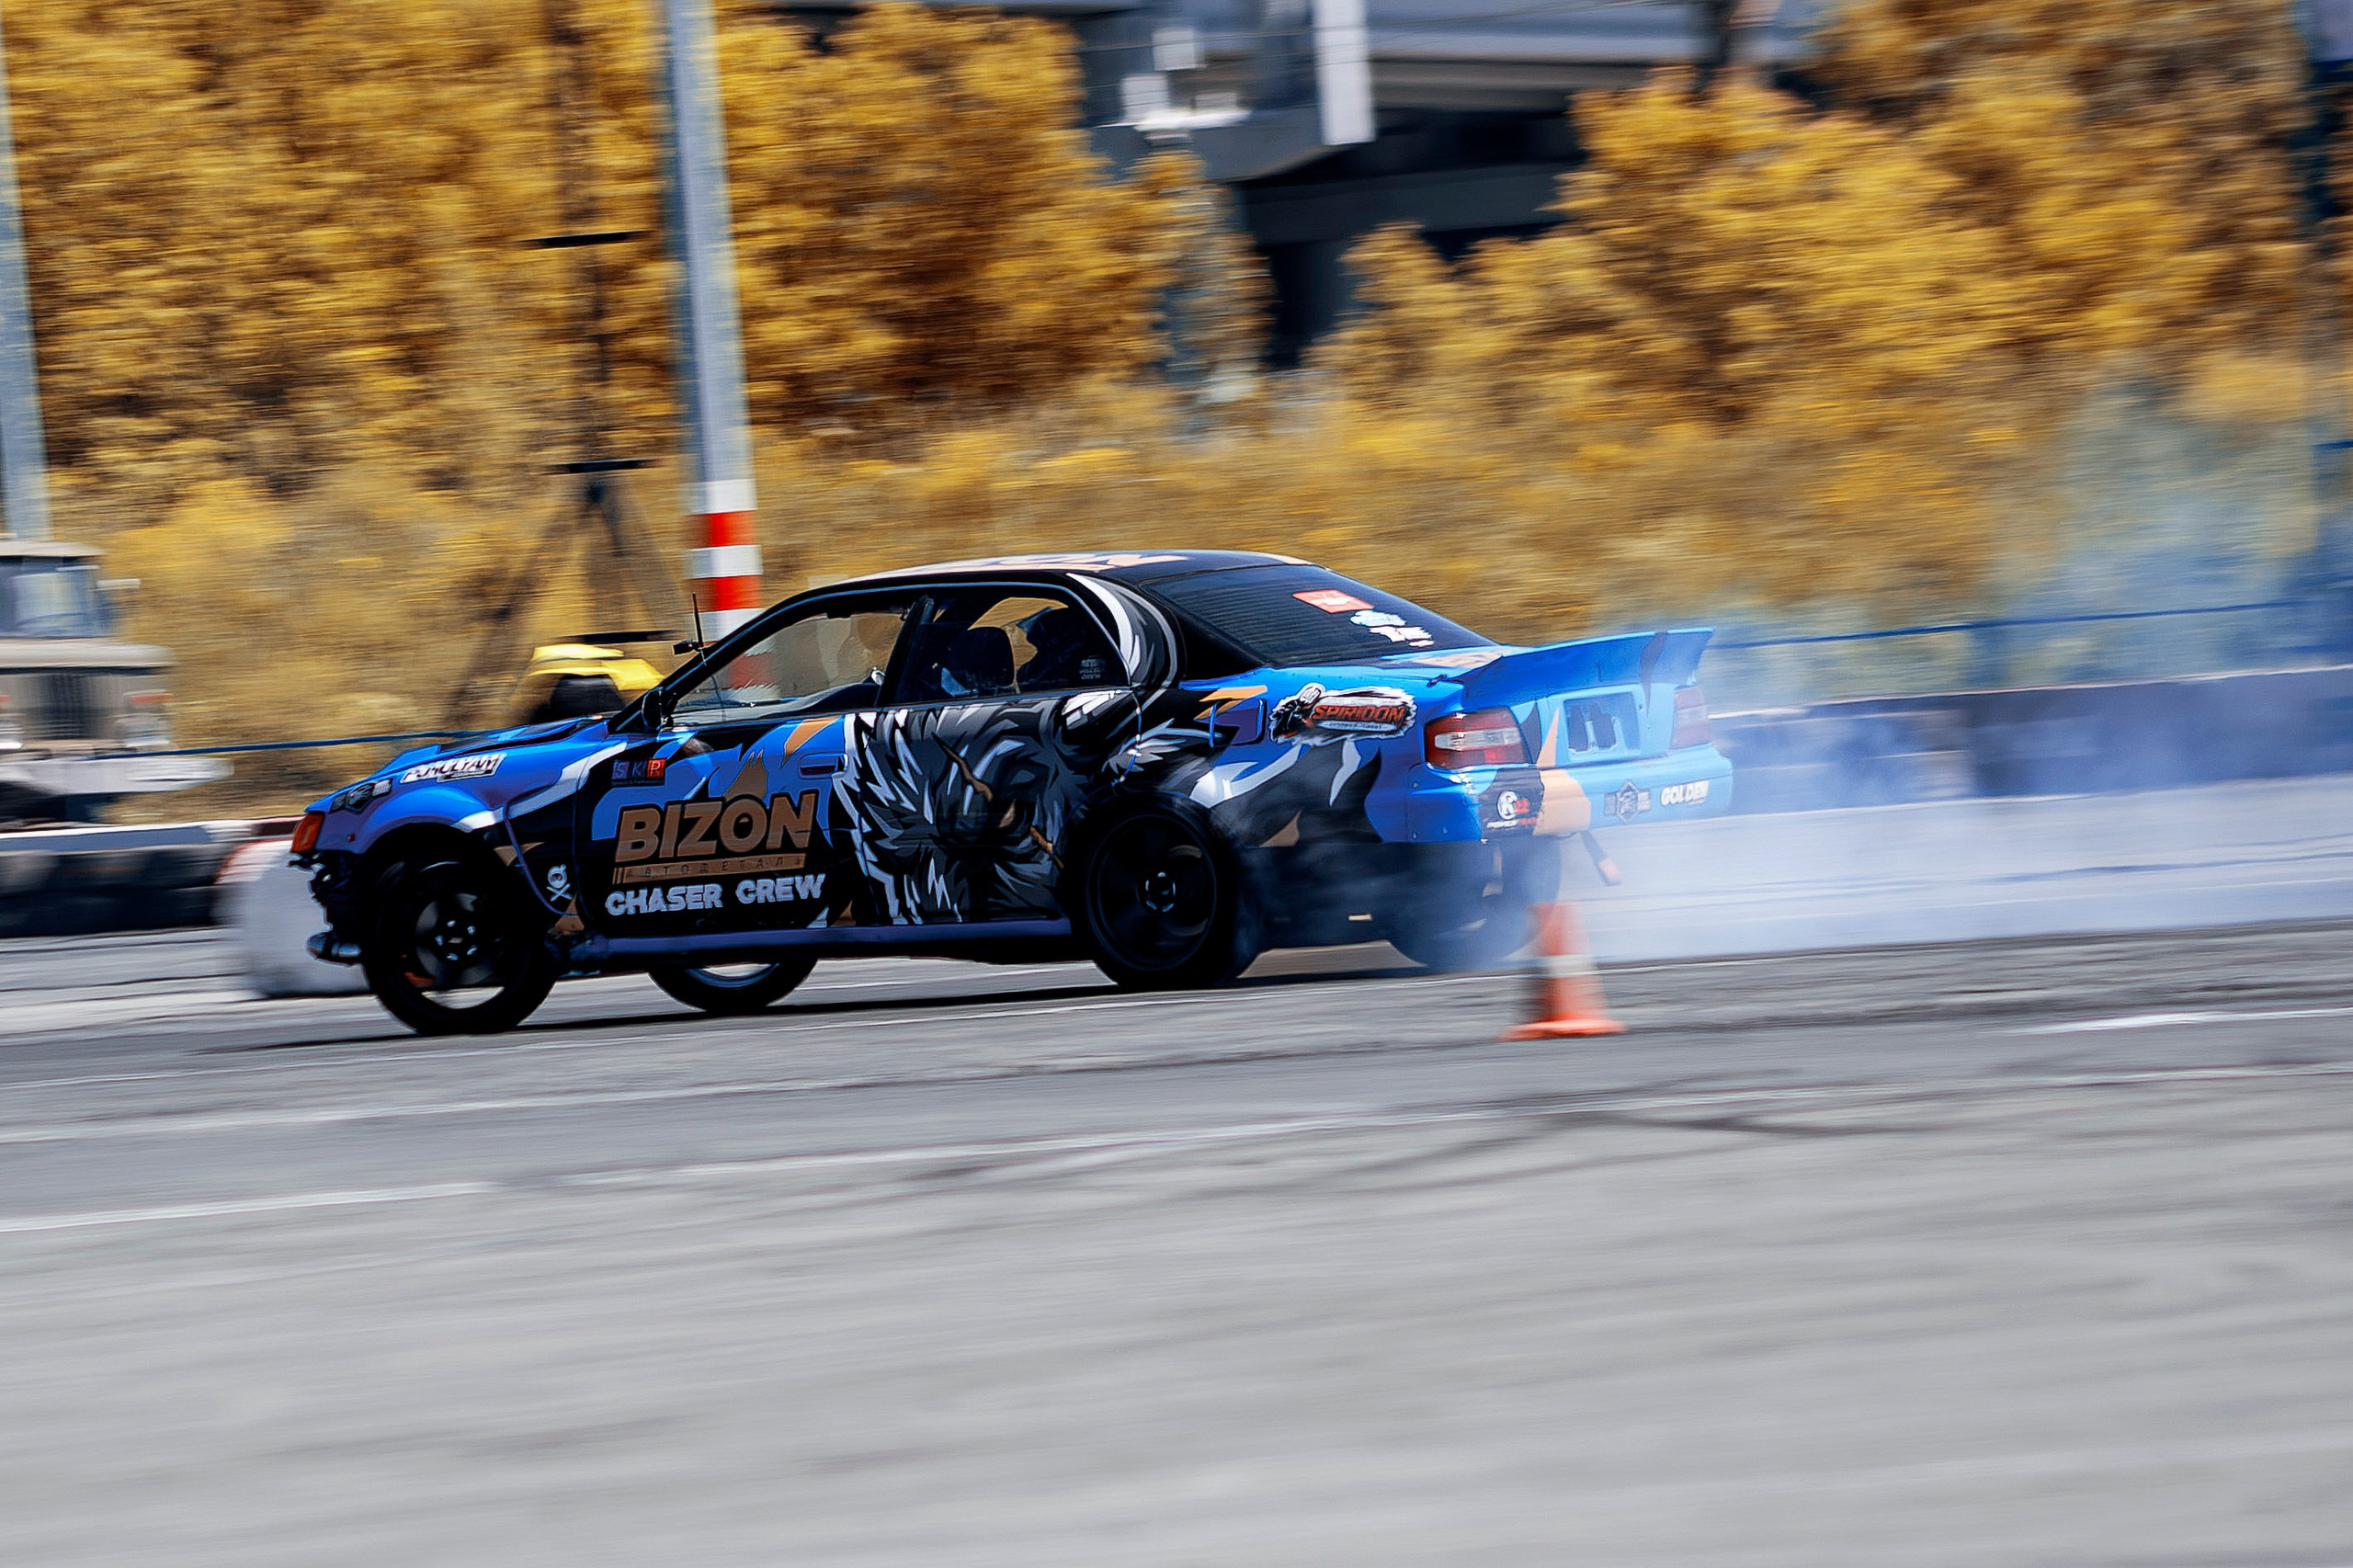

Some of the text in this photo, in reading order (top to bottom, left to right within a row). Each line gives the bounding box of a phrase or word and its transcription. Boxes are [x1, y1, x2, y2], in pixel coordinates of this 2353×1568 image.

[1311, 704, 1406, 723] SPIRIDON
[615, 793, 816, 862] BIZON
[605, 873, 825, 915] CHASER CREW
